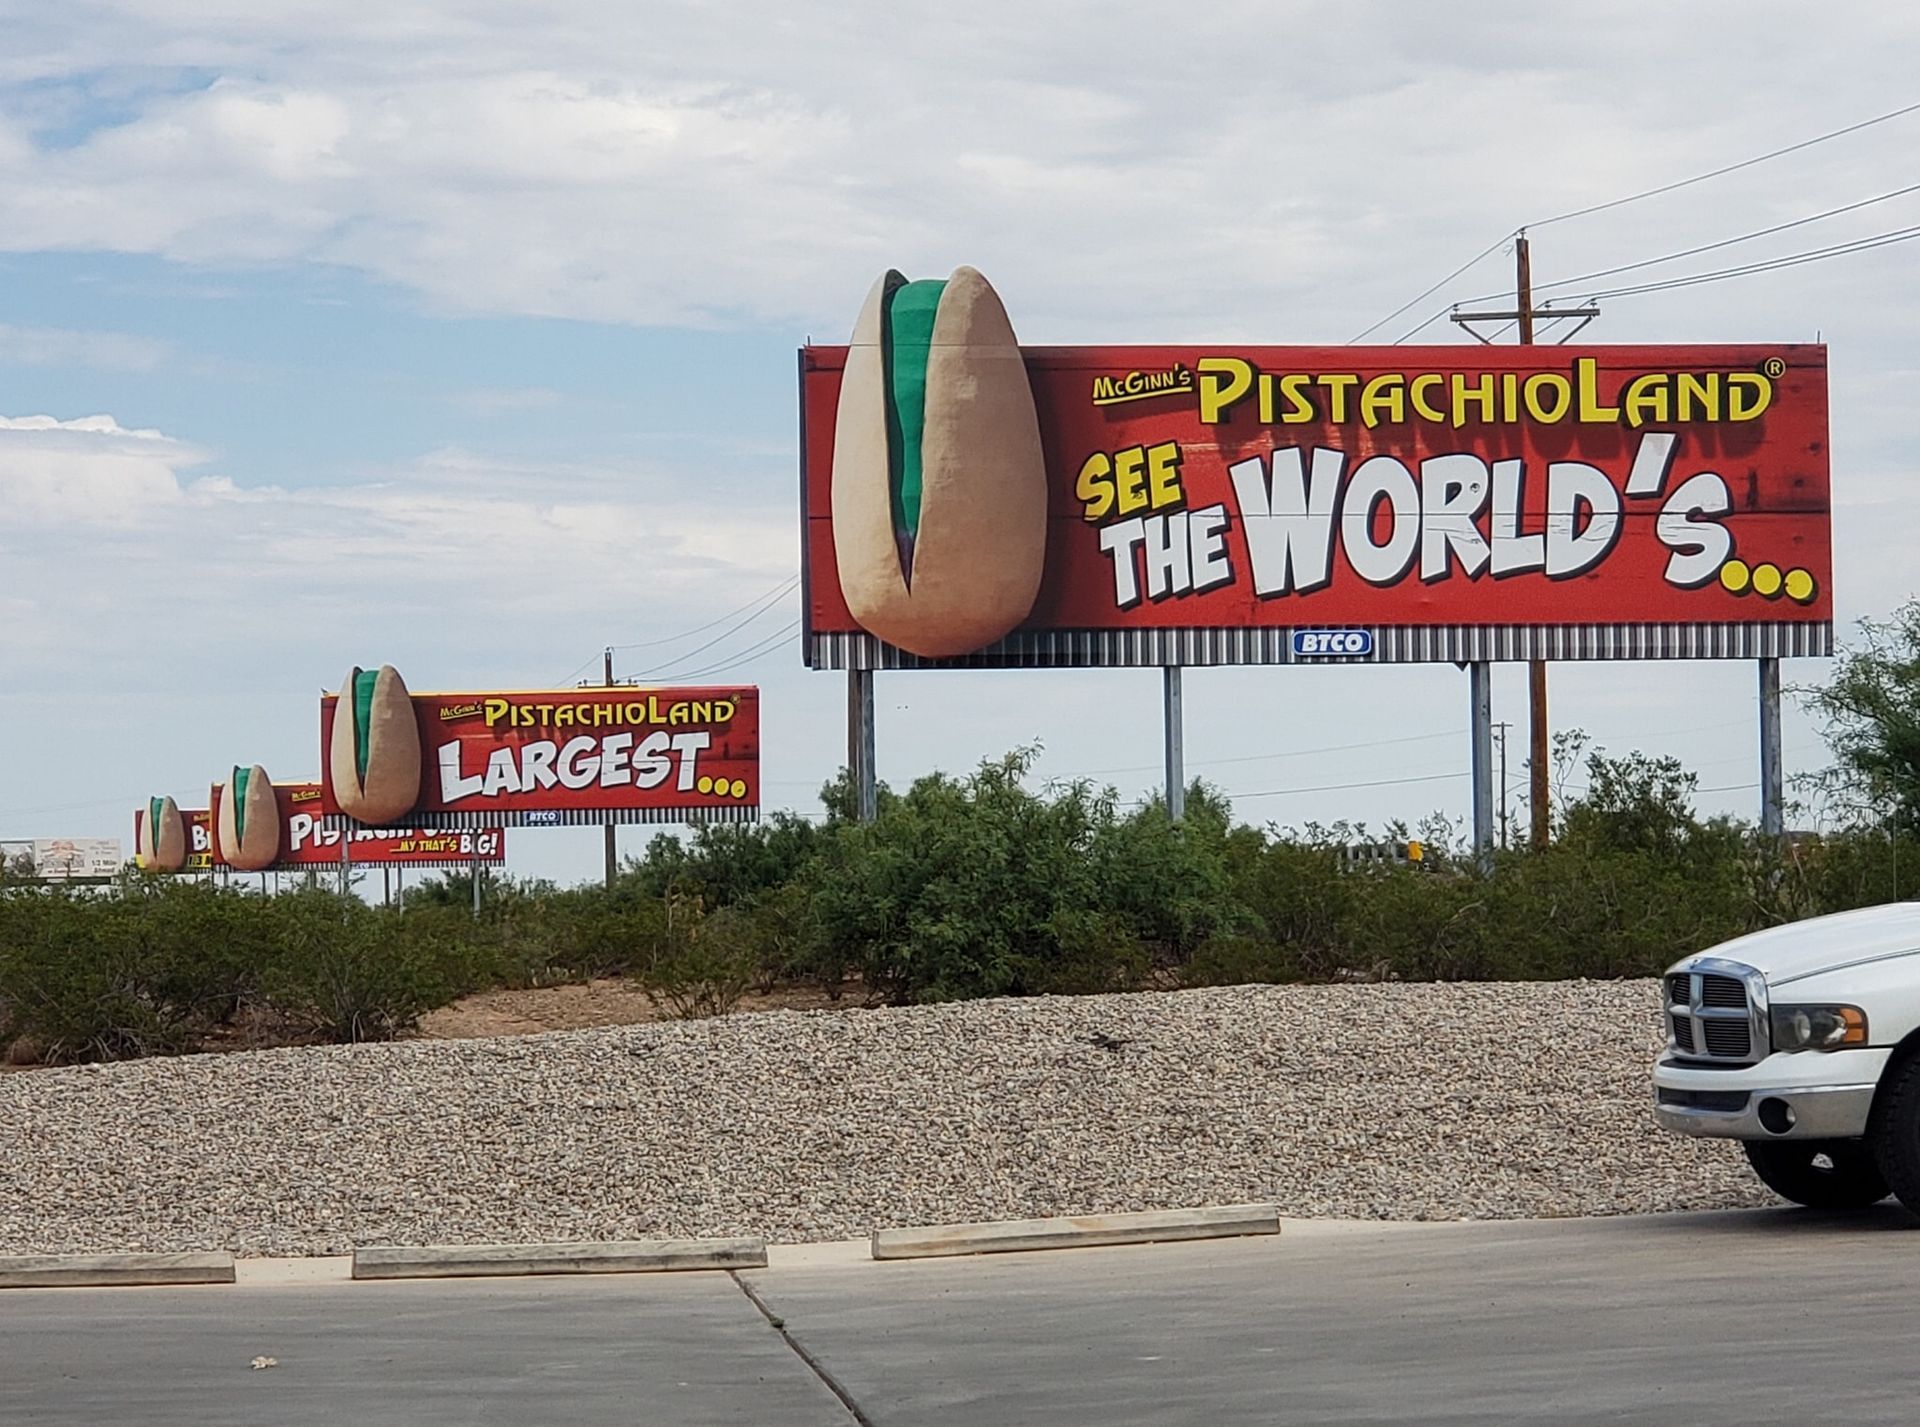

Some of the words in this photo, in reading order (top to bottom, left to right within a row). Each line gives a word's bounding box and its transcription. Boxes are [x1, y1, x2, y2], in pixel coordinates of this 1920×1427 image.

[1075, 441, 1182, 521] SEE
[1099, 504, 1231, 607] THE
[1301, 633, 1364, 653] BTCO
